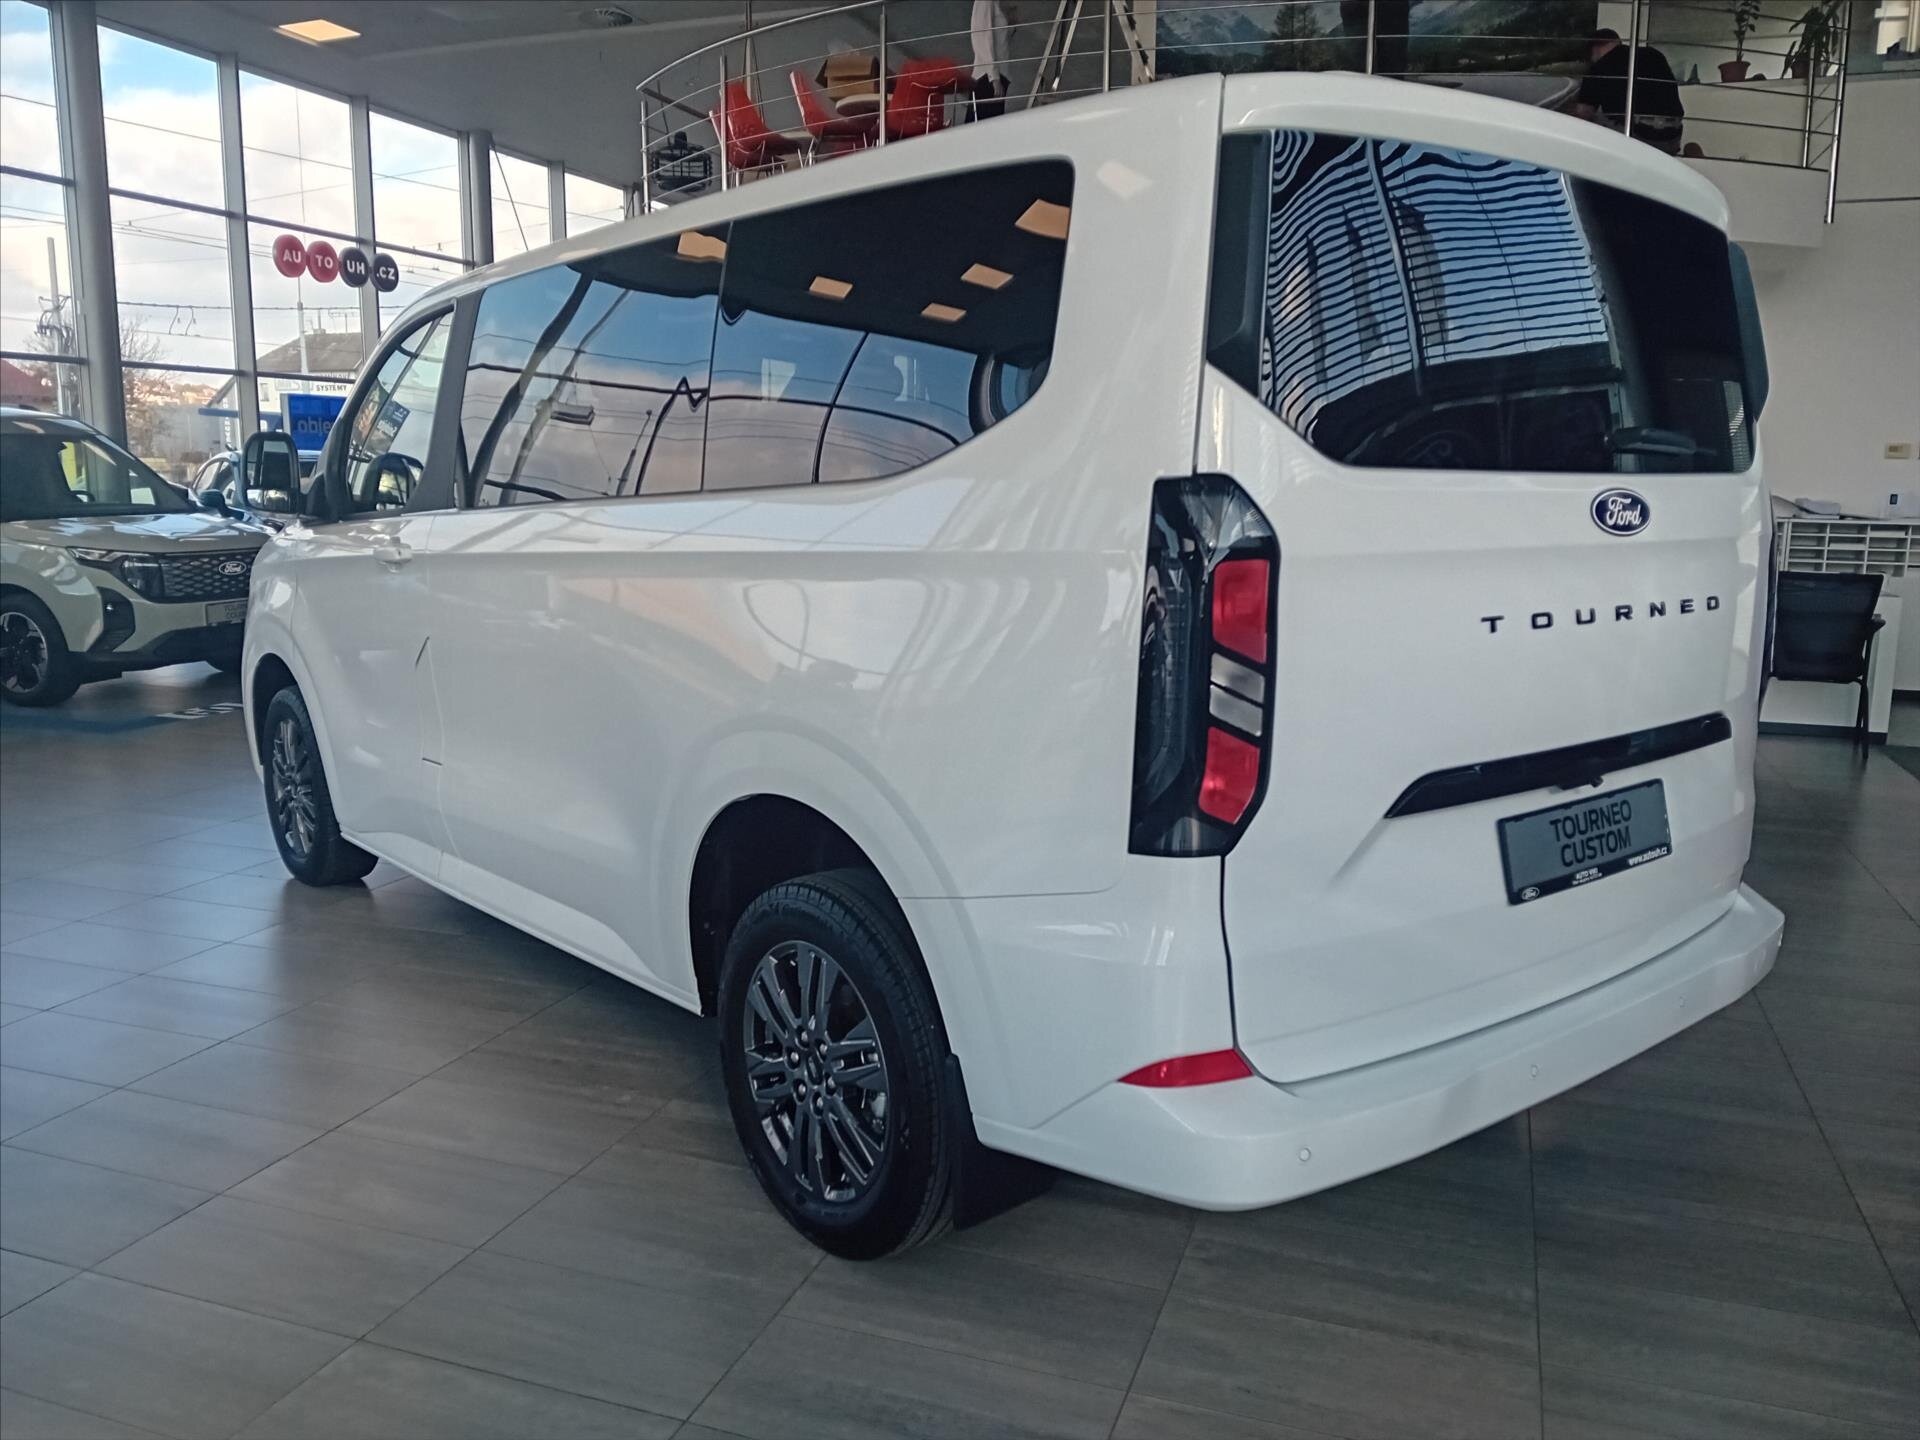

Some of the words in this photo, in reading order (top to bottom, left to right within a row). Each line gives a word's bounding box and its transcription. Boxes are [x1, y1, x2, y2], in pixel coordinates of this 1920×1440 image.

[1605, 496, 1643, 527] Ford
[1480, 595, 1720, 634] TOURNEO
[1550, 799, 1632, 842] TOURNEO
[1561, 826, 1632, 867] CUSTOM
